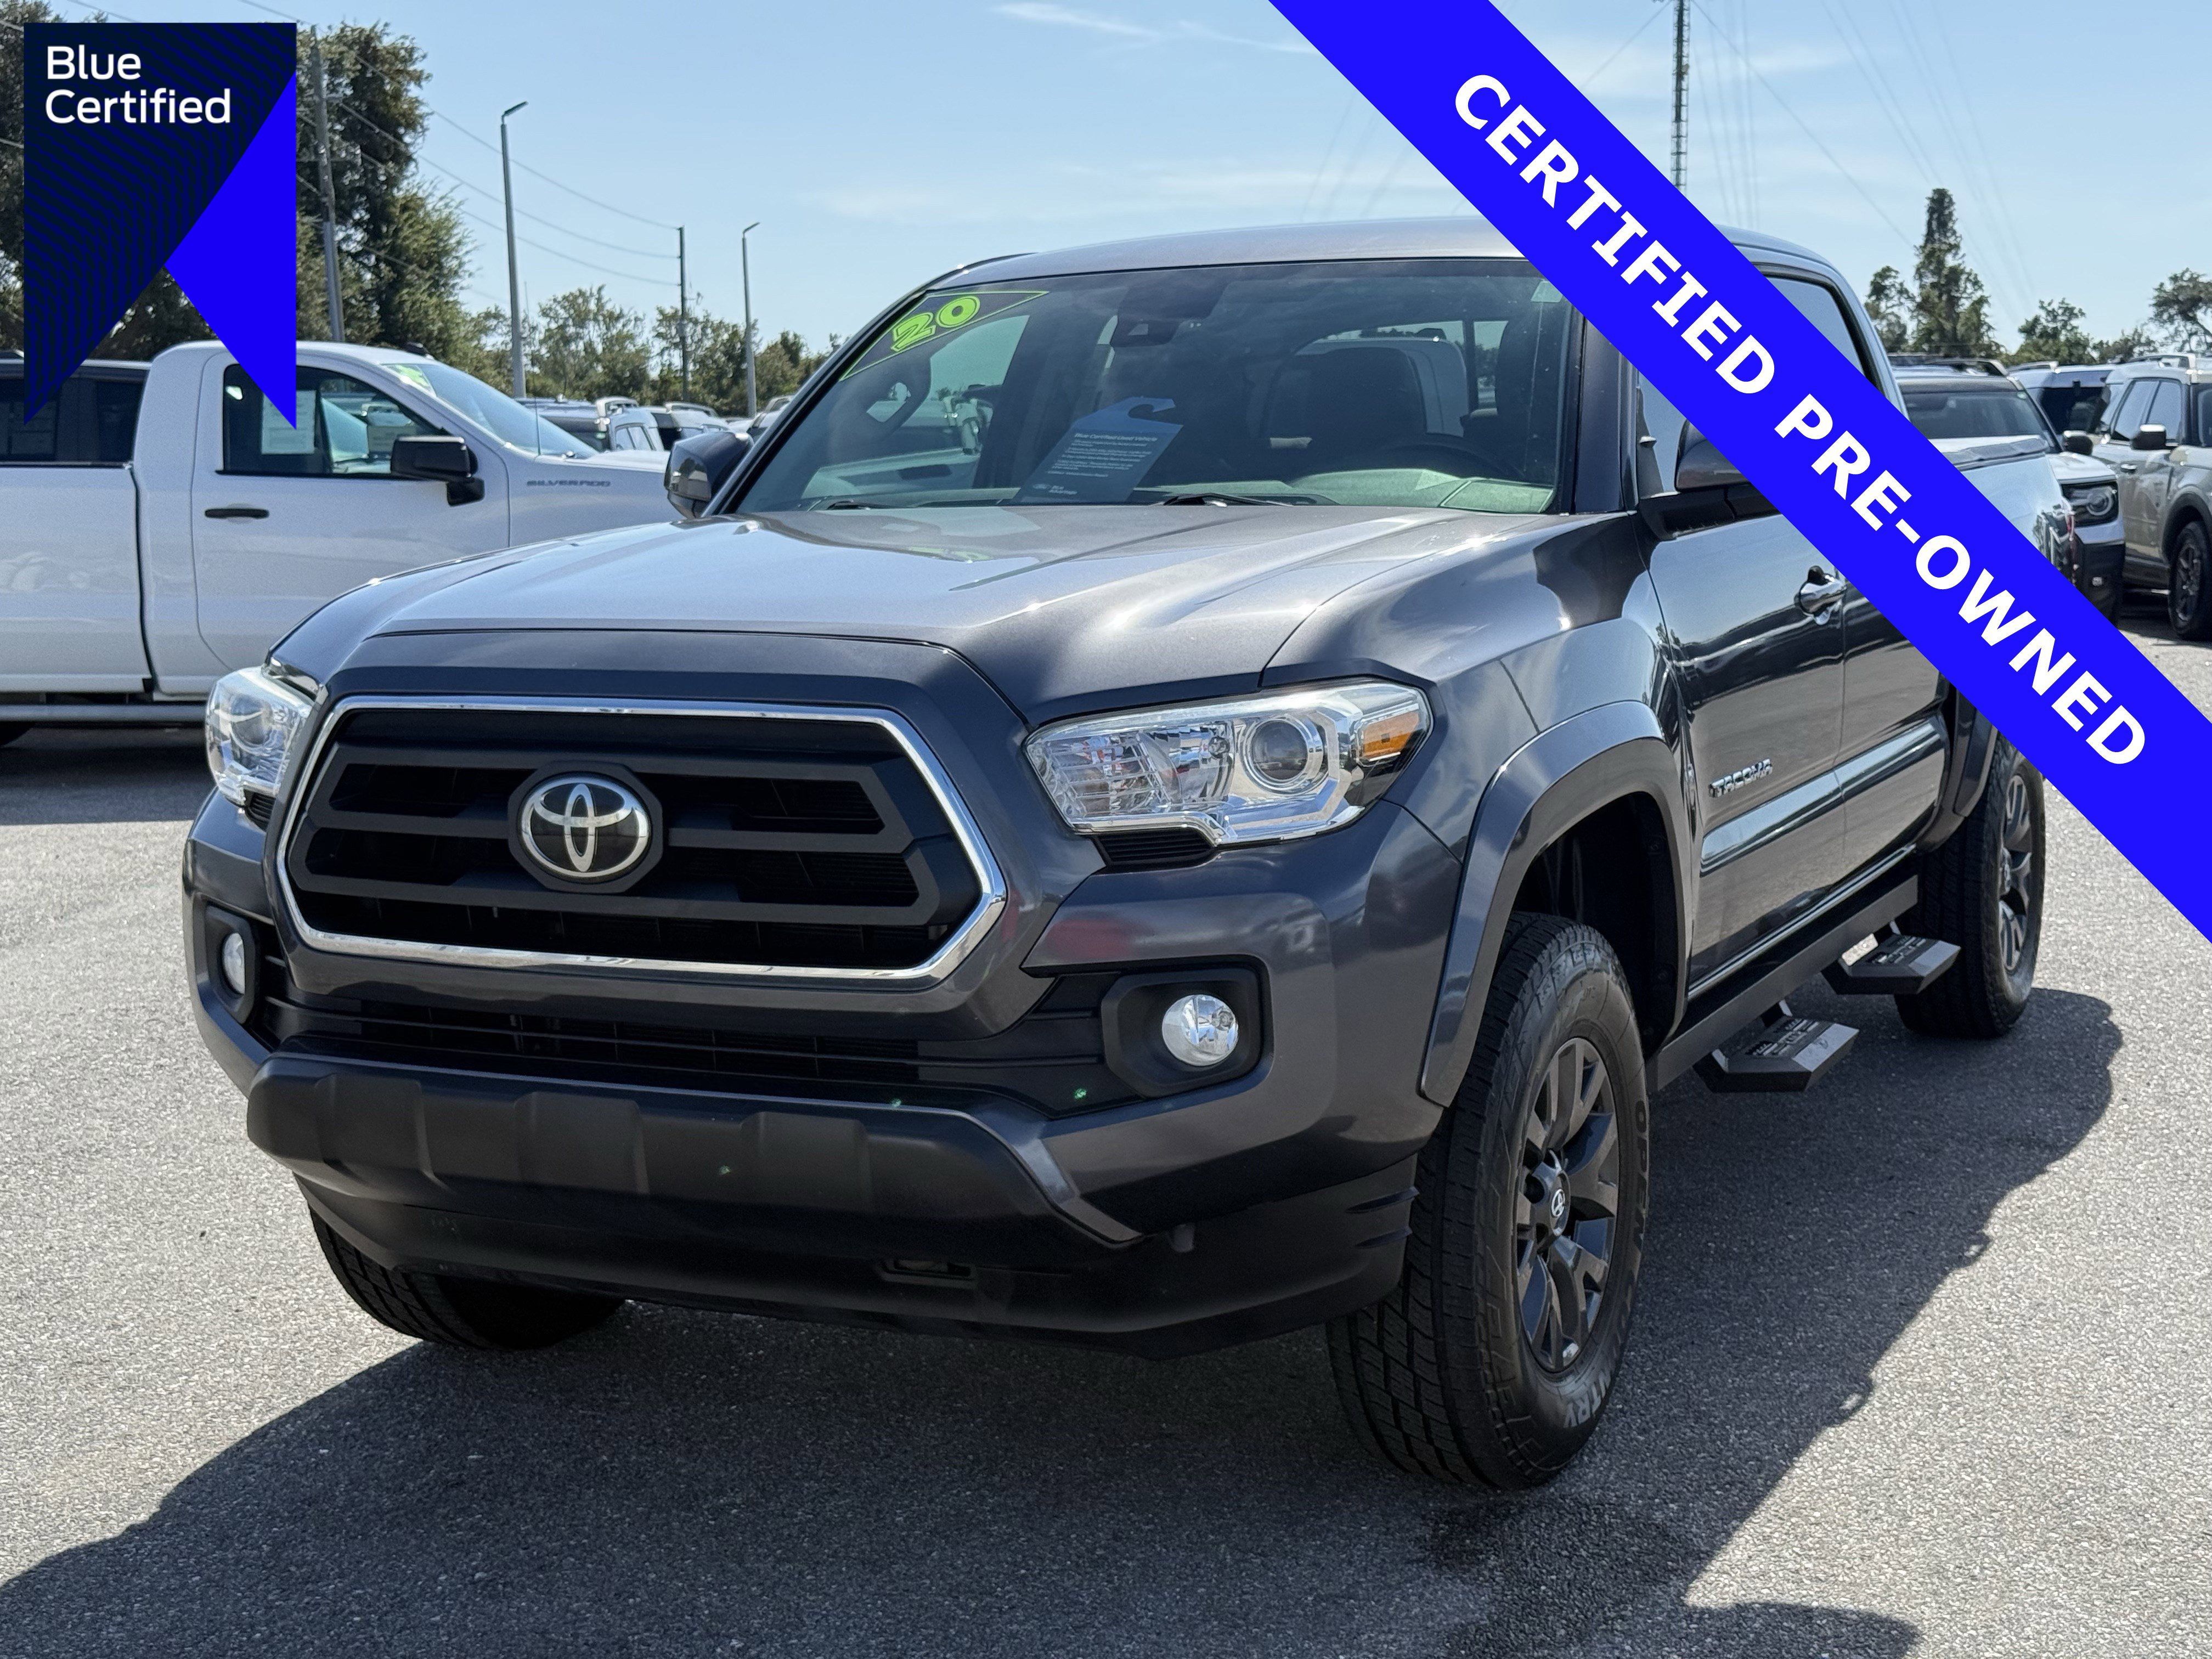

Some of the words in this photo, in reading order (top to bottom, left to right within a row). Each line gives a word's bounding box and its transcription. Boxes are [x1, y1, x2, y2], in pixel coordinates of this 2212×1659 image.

[890, 296, 980, 352] 20
[1708, 759, 1773, 797] TACOMA
[1633, 1099, 1649, 1253] OPEN
